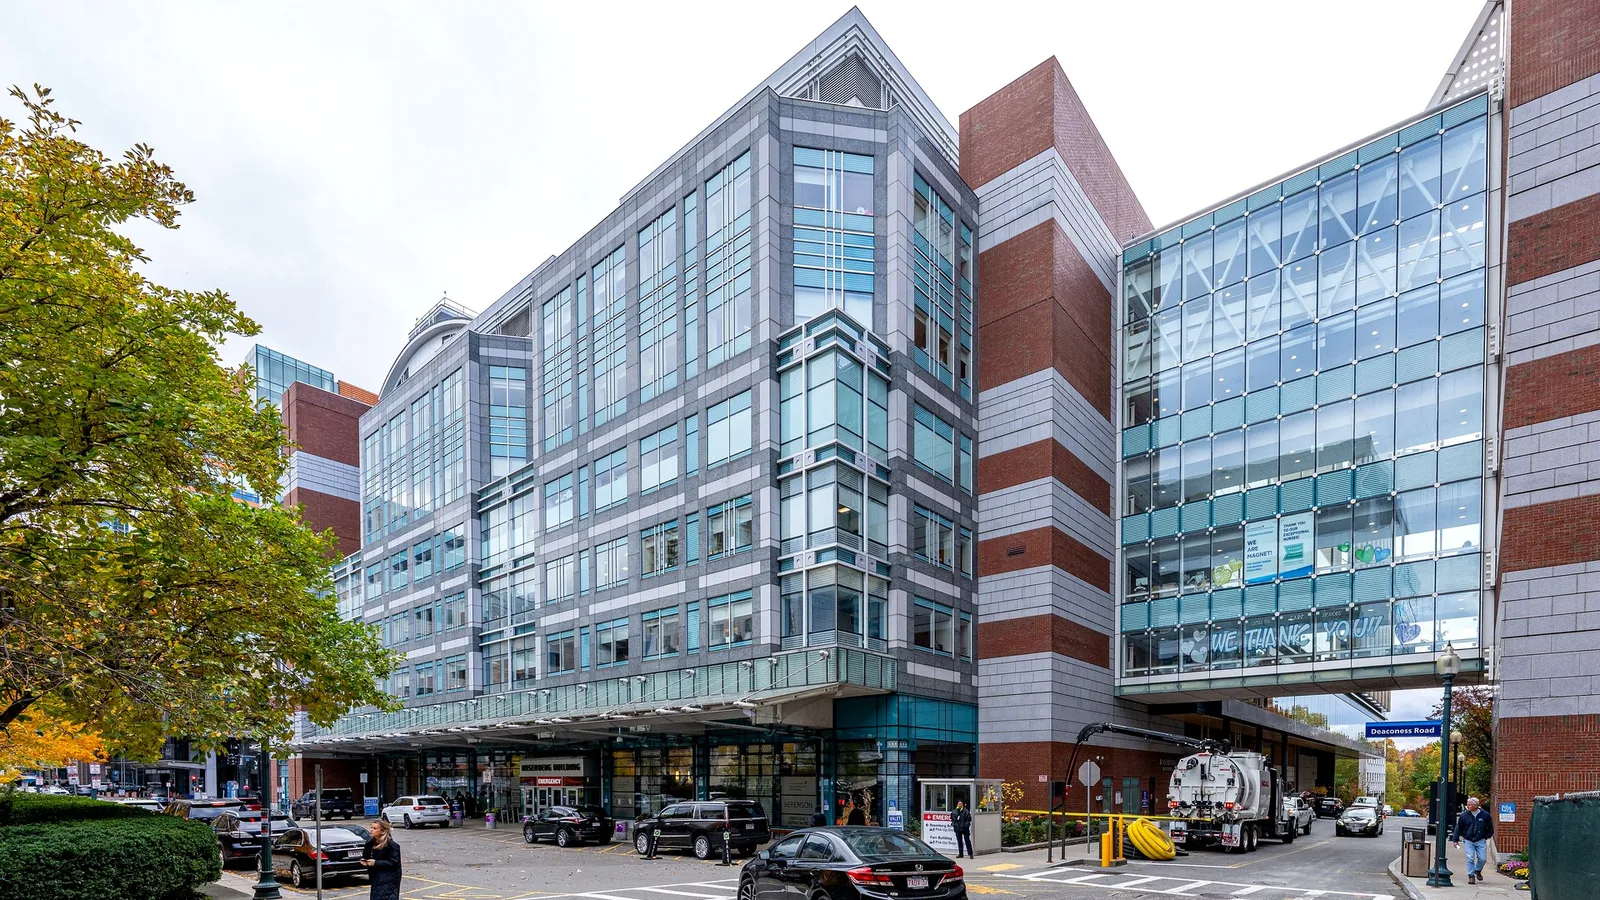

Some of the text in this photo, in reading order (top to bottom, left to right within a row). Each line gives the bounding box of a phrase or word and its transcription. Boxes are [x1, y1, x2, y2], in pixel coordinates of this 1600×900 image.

[1247, 551, 1272, 559] MAGNET!
[1211, 615, 1384, 652] WE THANK YOU!!
